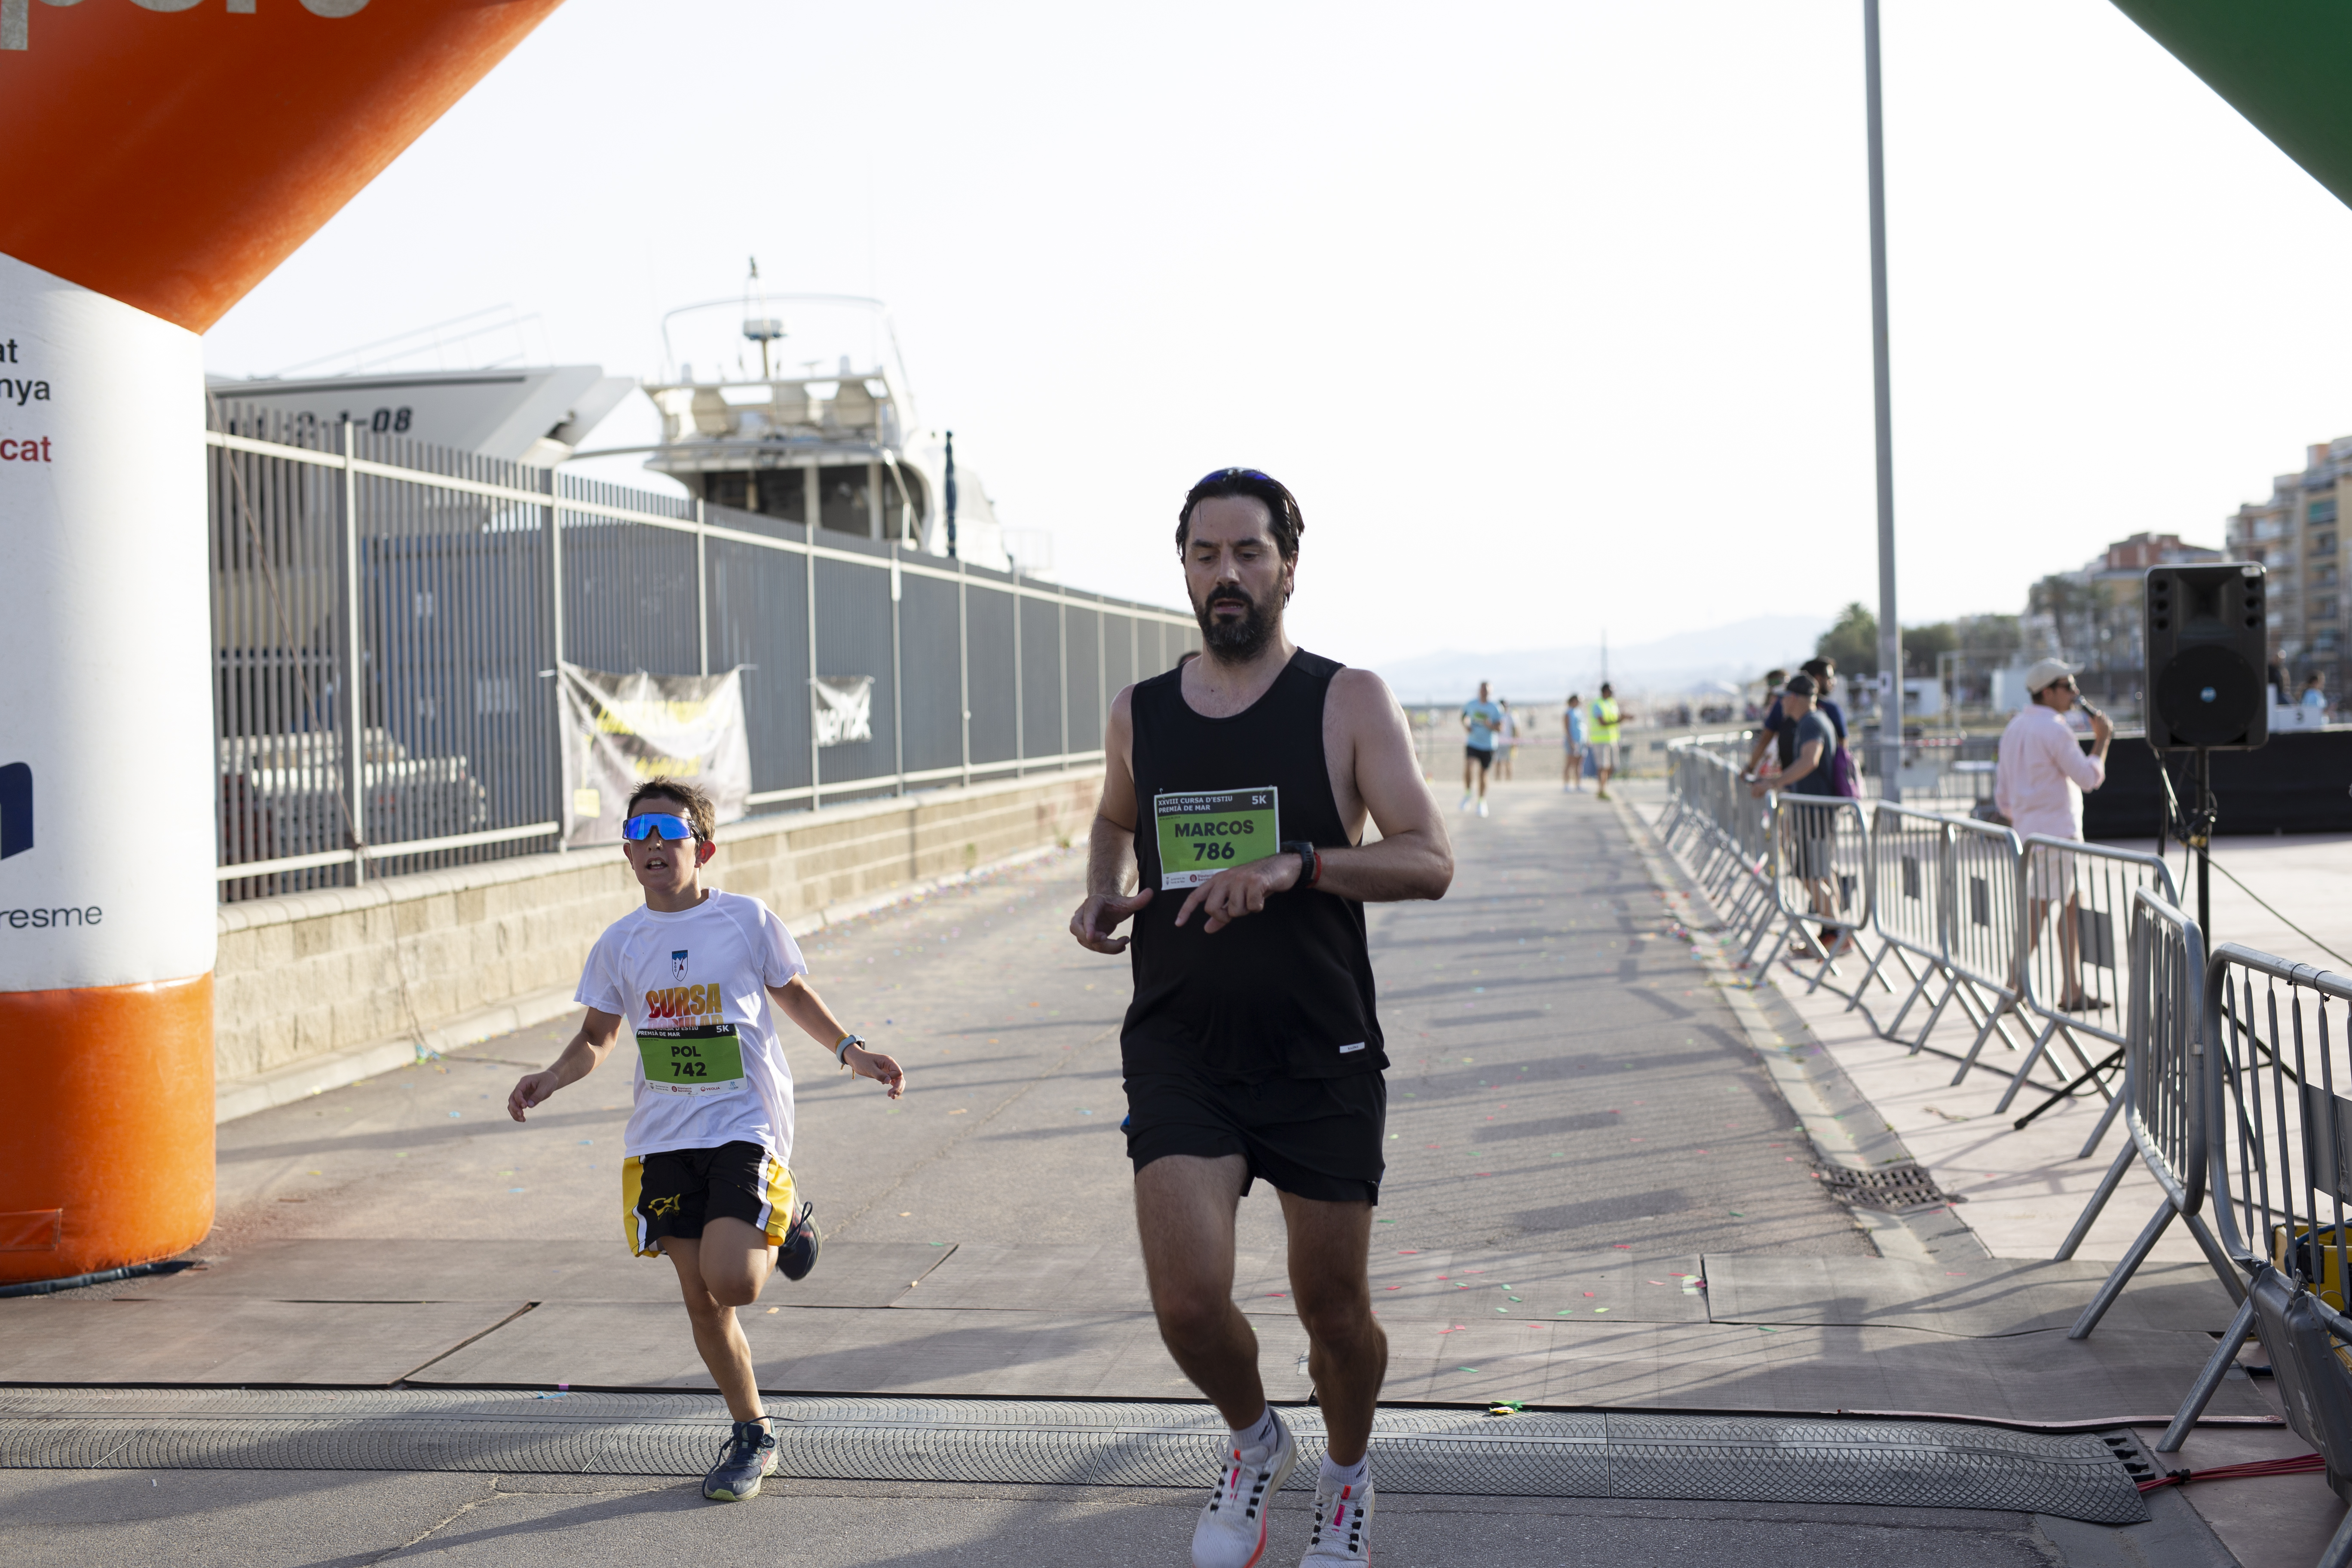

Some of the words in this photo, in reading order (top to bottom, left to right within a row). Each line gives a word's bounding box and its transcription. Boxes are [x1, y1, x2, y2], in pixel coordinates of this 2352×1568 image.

[0, 436, 52, 462] cat
[1158, 804, 1182, 813] PREMIÀ
[1252, 795, 1267, 805] 5K
[1175, 819, 1254, 838] MARCOS
[1193, 842, 1235, 861] 786
[646, 983, 723, 1018] CURSA
[671, 1046, 701, 1057] POL
[671, 1062, 707, 1077] 742
